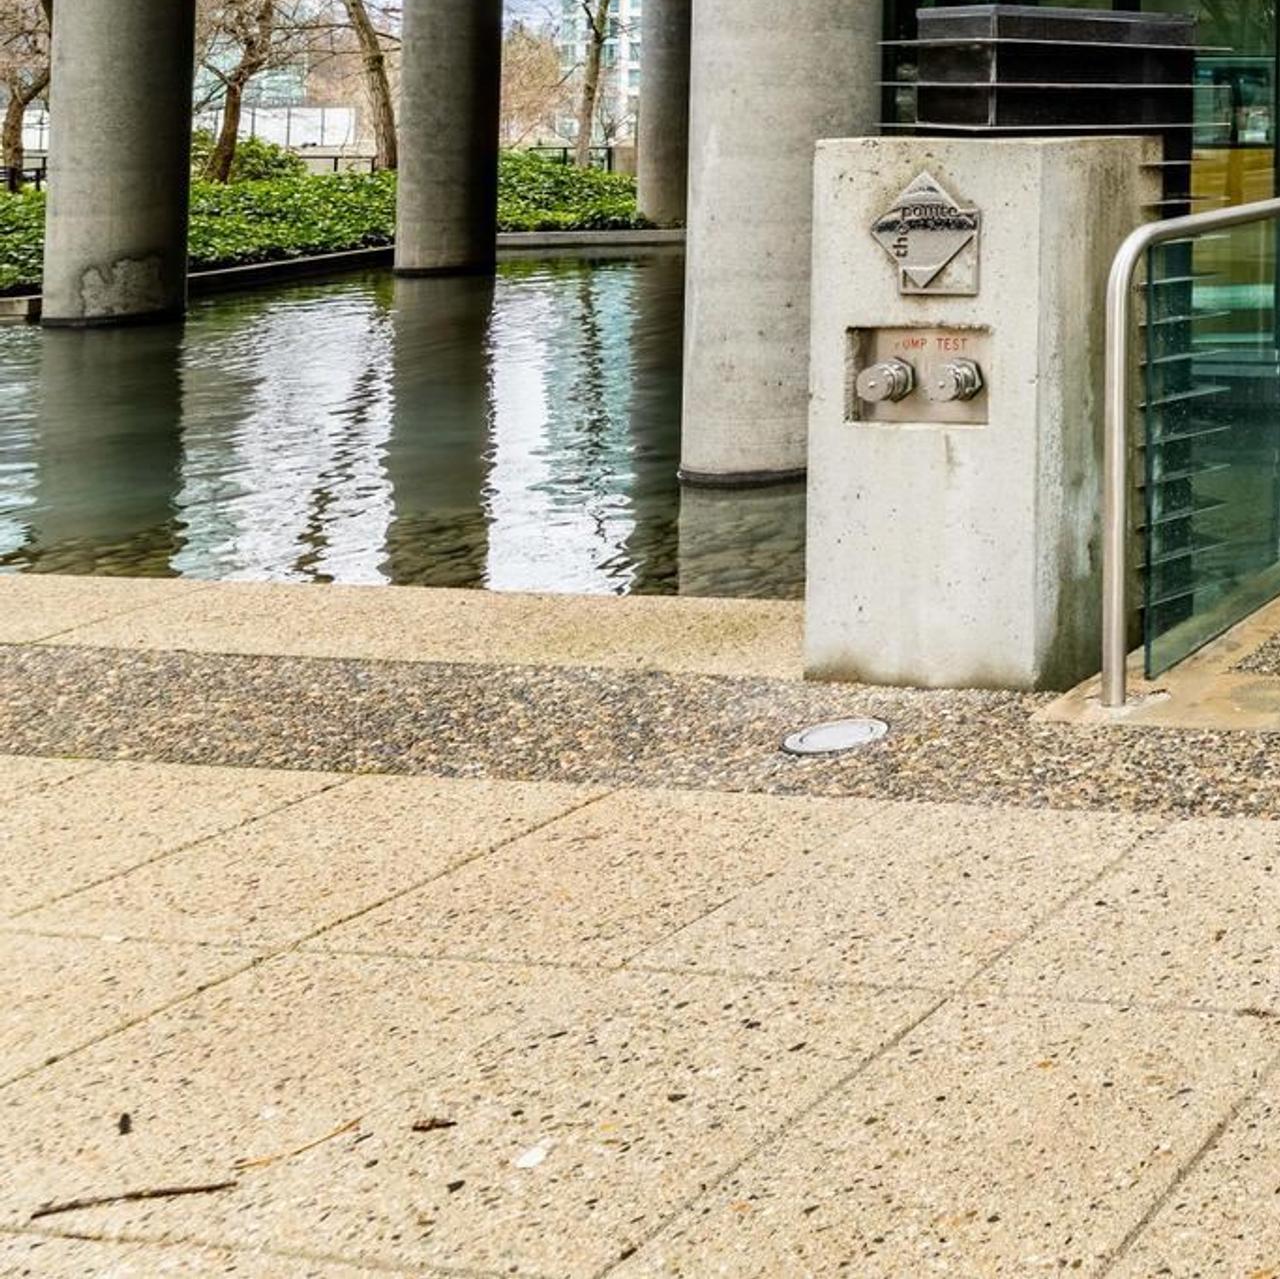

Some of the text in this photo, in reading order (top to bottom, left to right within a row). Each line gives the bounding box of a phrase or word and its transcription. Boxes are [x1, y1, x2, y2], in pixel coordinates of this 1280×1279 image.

[901, 202, 960, 220] pointe
[895, 336, 968, 351] UMP TEST
